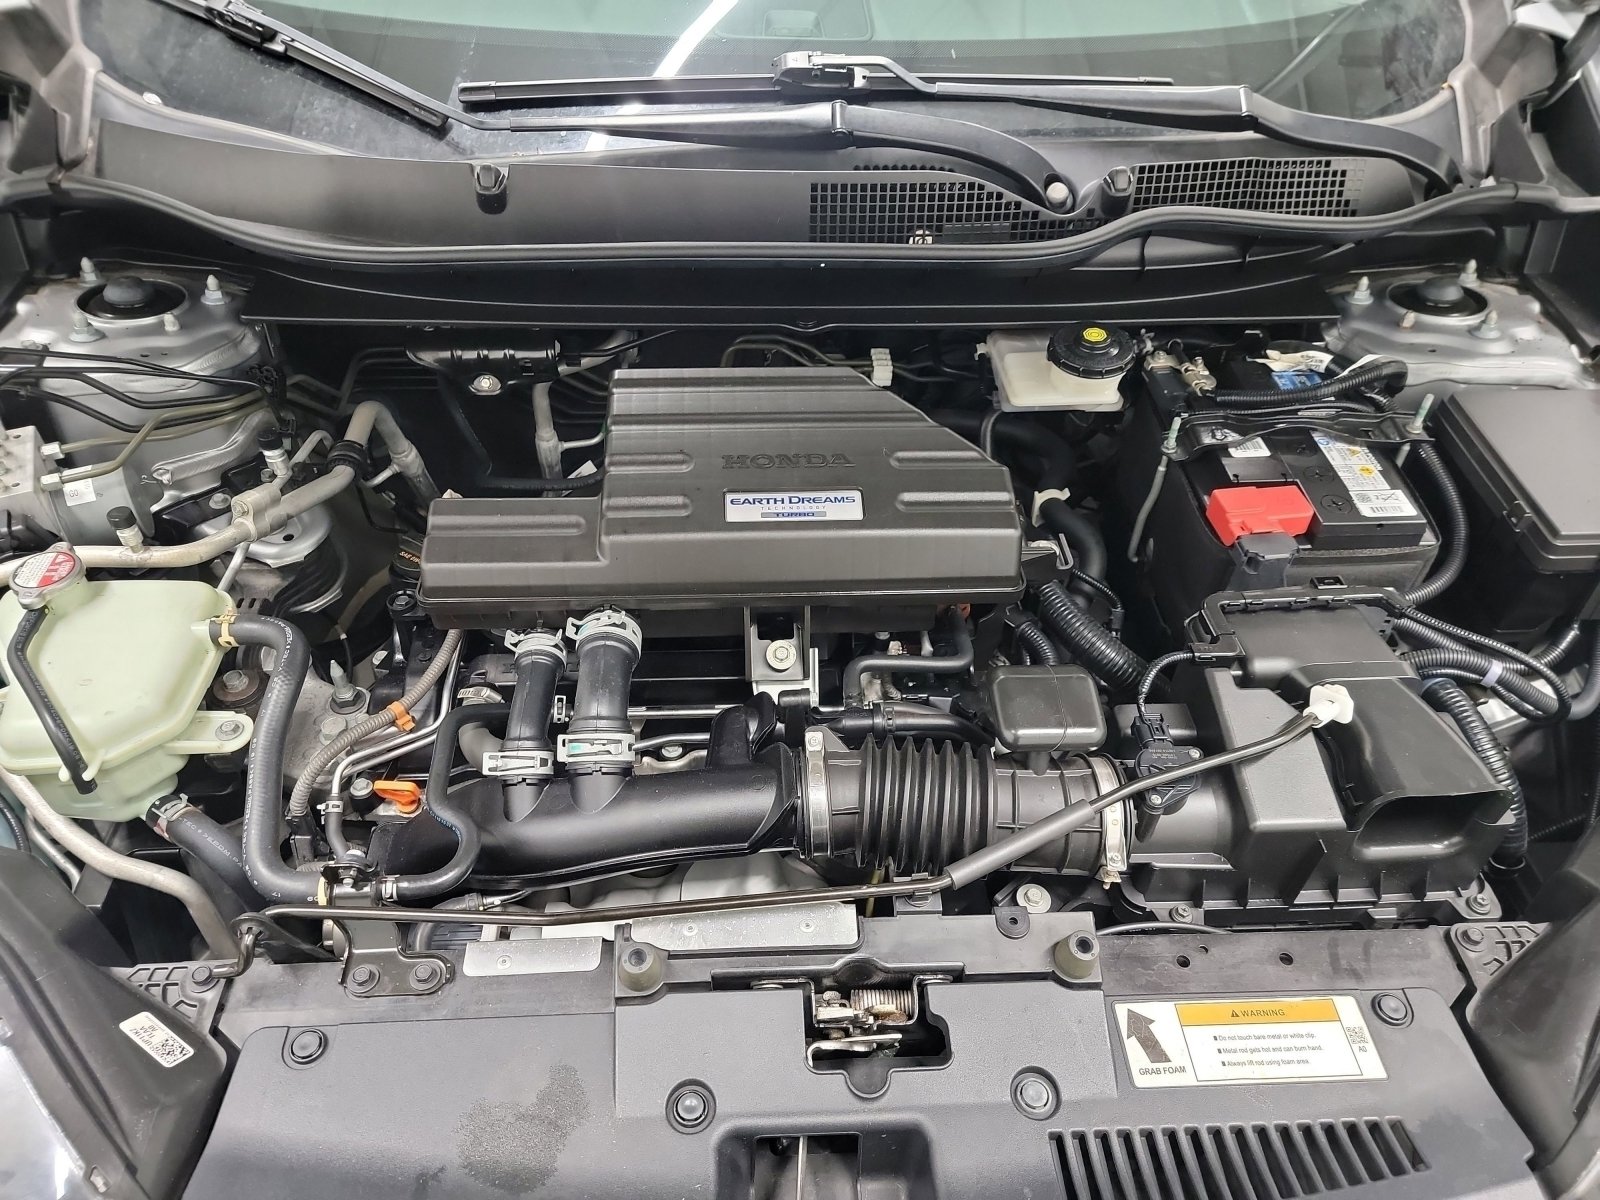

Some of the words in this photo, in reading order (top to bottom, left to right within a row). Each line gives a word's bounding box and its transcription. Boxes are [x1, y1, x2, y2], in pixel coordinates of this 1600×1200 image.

[721, 453, 856, 469] HONDA
[730, 497, 785, 505] EARTH
[788, 496, 856, 505] DREAMS
[1240, 1008, 1286, 1018] WARNING
[1249, 1047, 1261, 1055] gets
[1138, 1068, 1162, 1076] GRAB
[1163, 1066, 1187, 1075] FOAM
